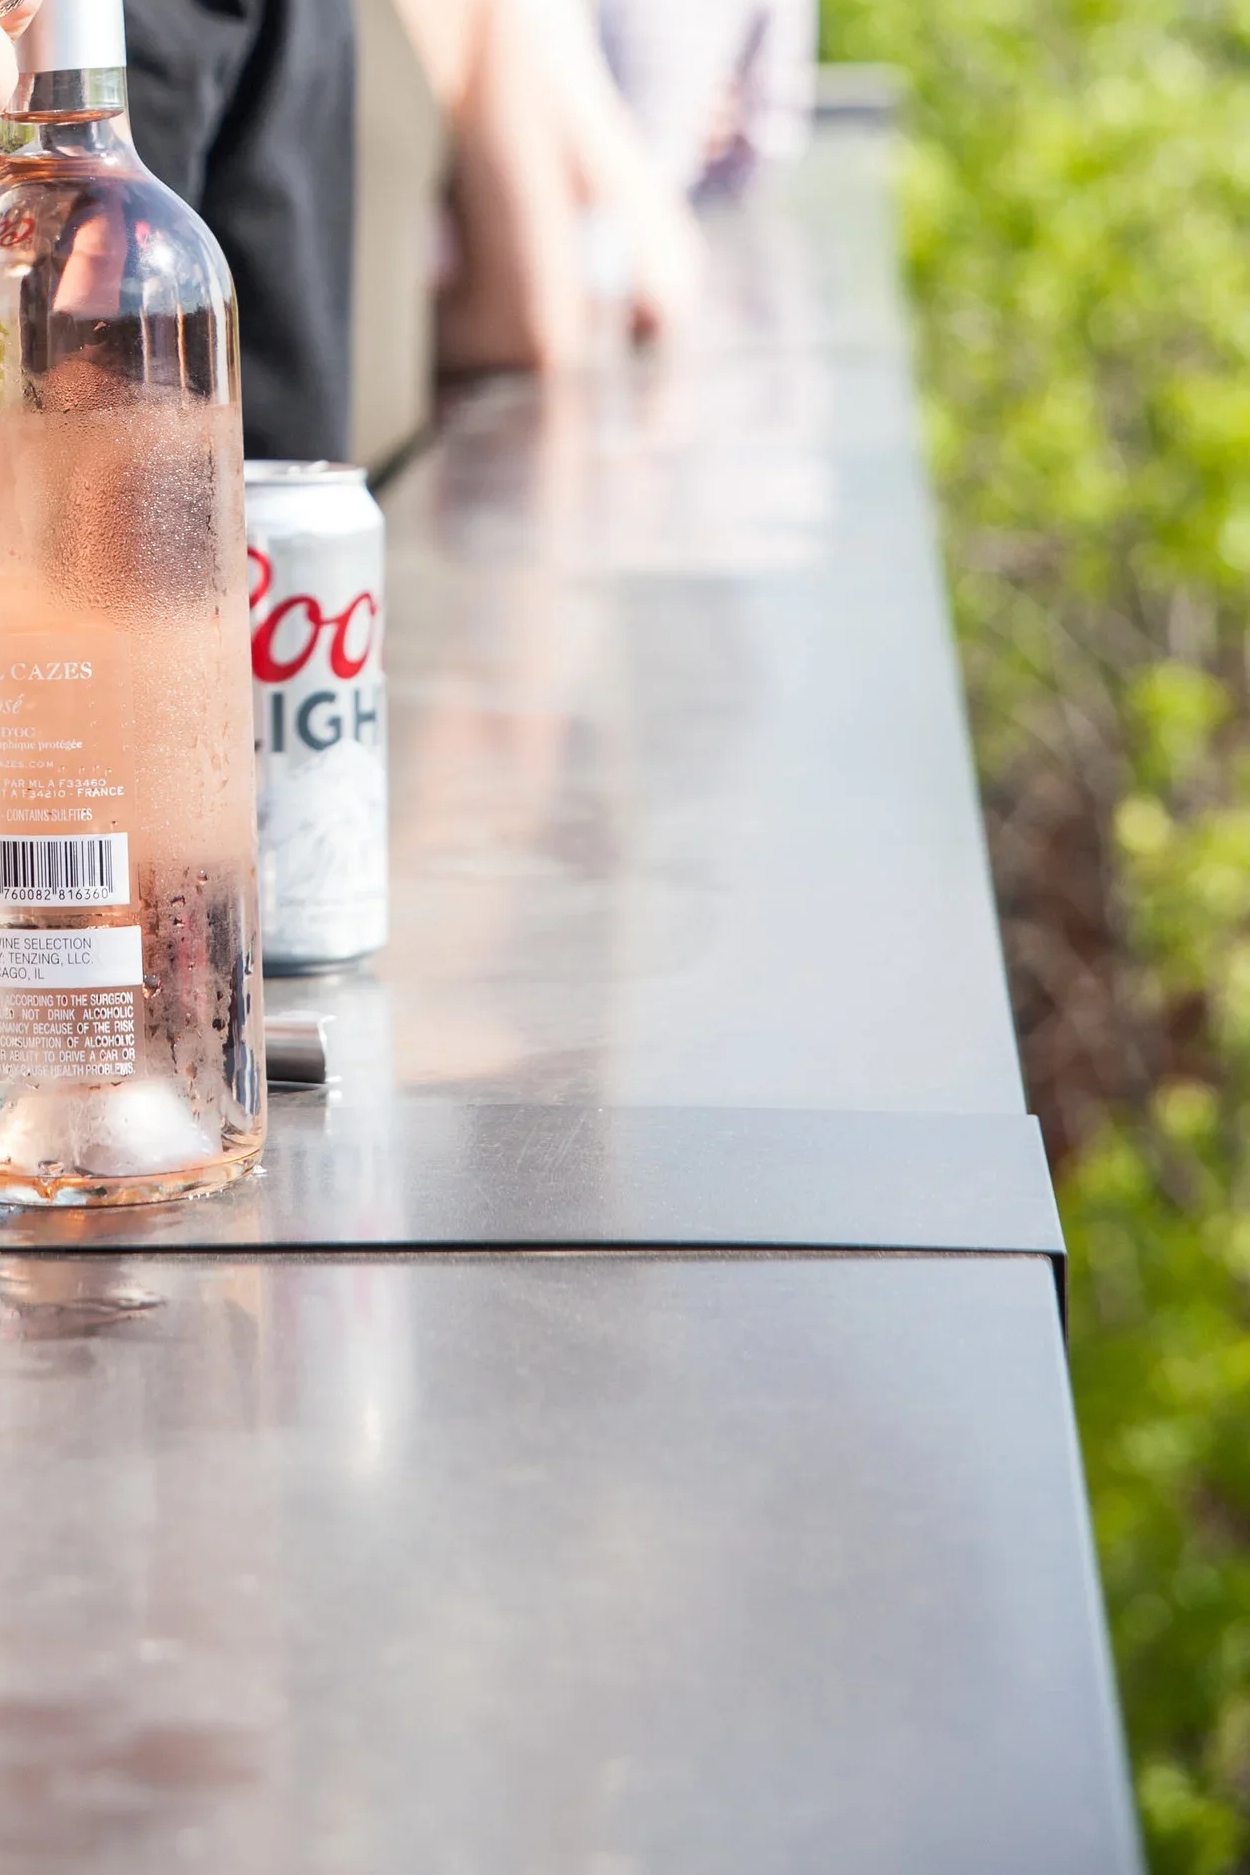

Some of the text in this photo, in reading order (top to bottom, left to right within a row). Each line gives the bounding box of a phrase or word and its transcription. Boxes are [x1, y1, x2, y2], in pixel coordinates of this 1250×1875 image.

[247, 543, 380, 684] oo
[11, 661, 93, 681] CAZES
[37, 739, 83, 752] protégée
[3, 778, 25, 789] PAR
[58, 777, 107, 789] F33460
[76, 785, 125, 798] FRANCE
[6, 807, 49, 822] CONTAINS
[51, 807, 93, 822] SULFITES
[3, 888, 52, 901] 760082
[57, 888, 109, 901] 816360
[24, 937, 92, 951] SELECTION
[8, 951, 64, 967] TENZING,
[34, 968, 45, 981] IL
[7, 993, 53, 1006] ACCORDING
[56, 994, 68, 1006] TO
[70, 993, 88, 1006] THE
[89, 991, 134, 1006] SURGEON
[21, 1008, 40, 1021] NOT
[47, 1008, 76, 1021] DRINK
[82, 1005, 135, 1021] ALCOHOLIC
[32, 1022, 74, 1035] BECAUSE
[76, 1022, 90, 1034] OF
[92, 1021, 111, 1034] THE
[114, 1019, 135, 1032] RISK
[0, 1036, 62, 1049] CONSUMPTION
[66, 1036, 80, 1049] OF
[84, 1033, 135, 1048] ALCOHOLIC
[44, 1050, 56, 1063] TO
[59, 1049, 86, 1063] DRIVE
[90, 1049, 97, 1062] A
[99, 1048, 119, 1062] CAR
[121, 1046, 136, 1062] OR
